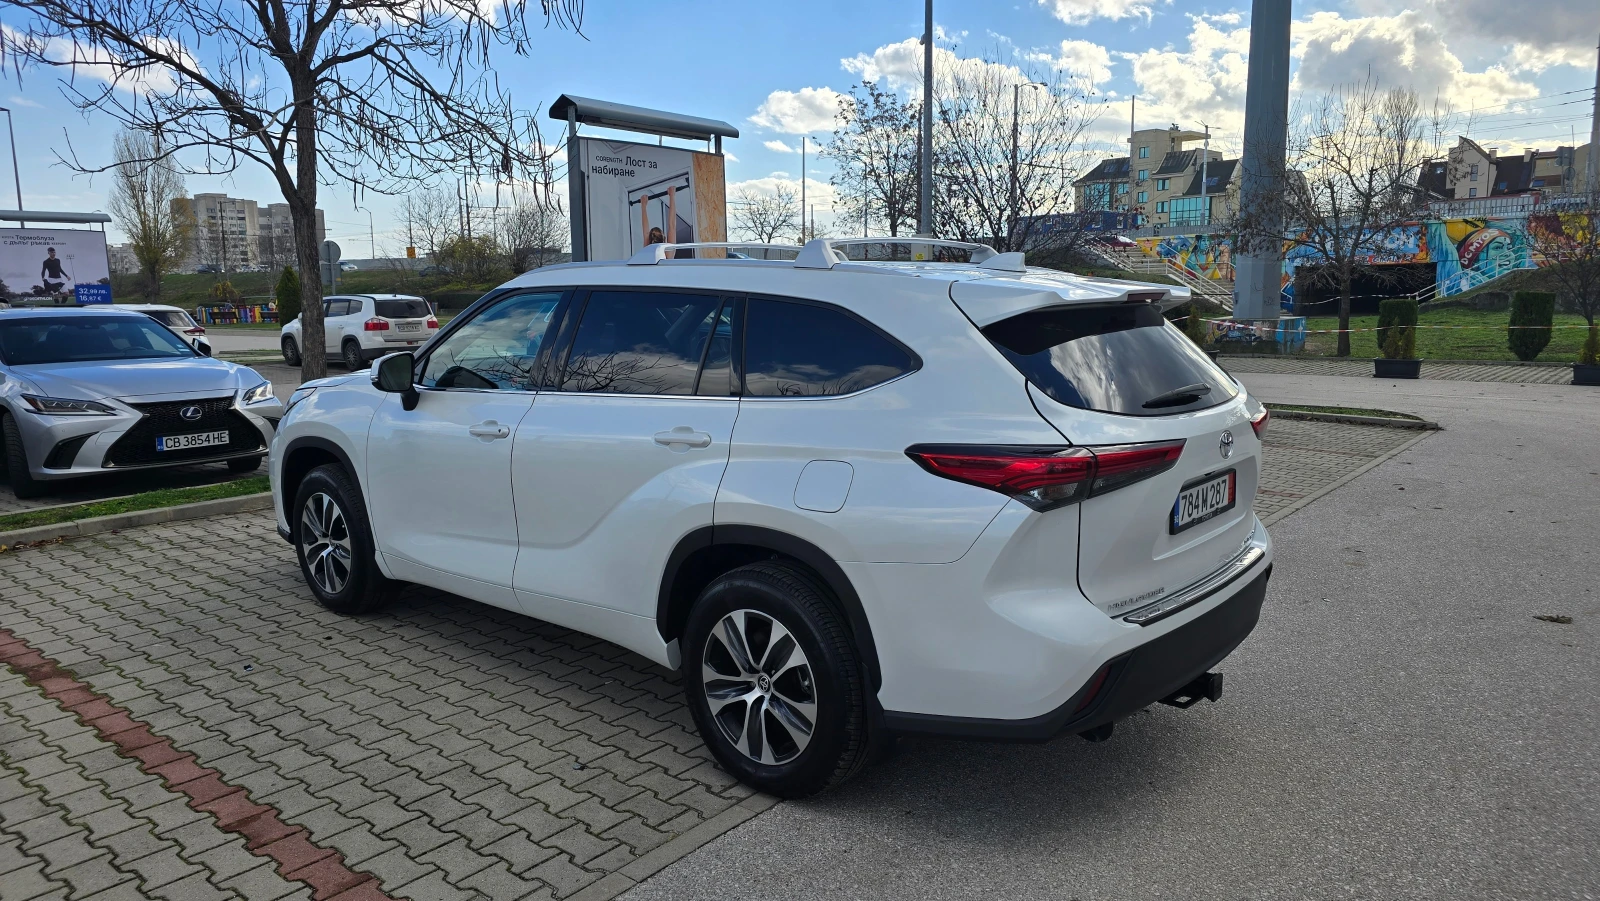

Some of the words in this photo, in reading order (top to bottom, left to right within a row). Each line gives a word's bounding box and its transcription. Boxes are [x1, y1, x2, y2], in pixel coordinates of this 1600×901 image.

[595, 155, 623, 164] CORENGTH
[625, 156, 647, 168] Лост
[648, 161, 658, 169] за
[591, 165, 635, 178] набиране
[165, 437, 181, 449] CB
[183, 434, 211, 447] 3854
[212, 432, 227, 443] HE
